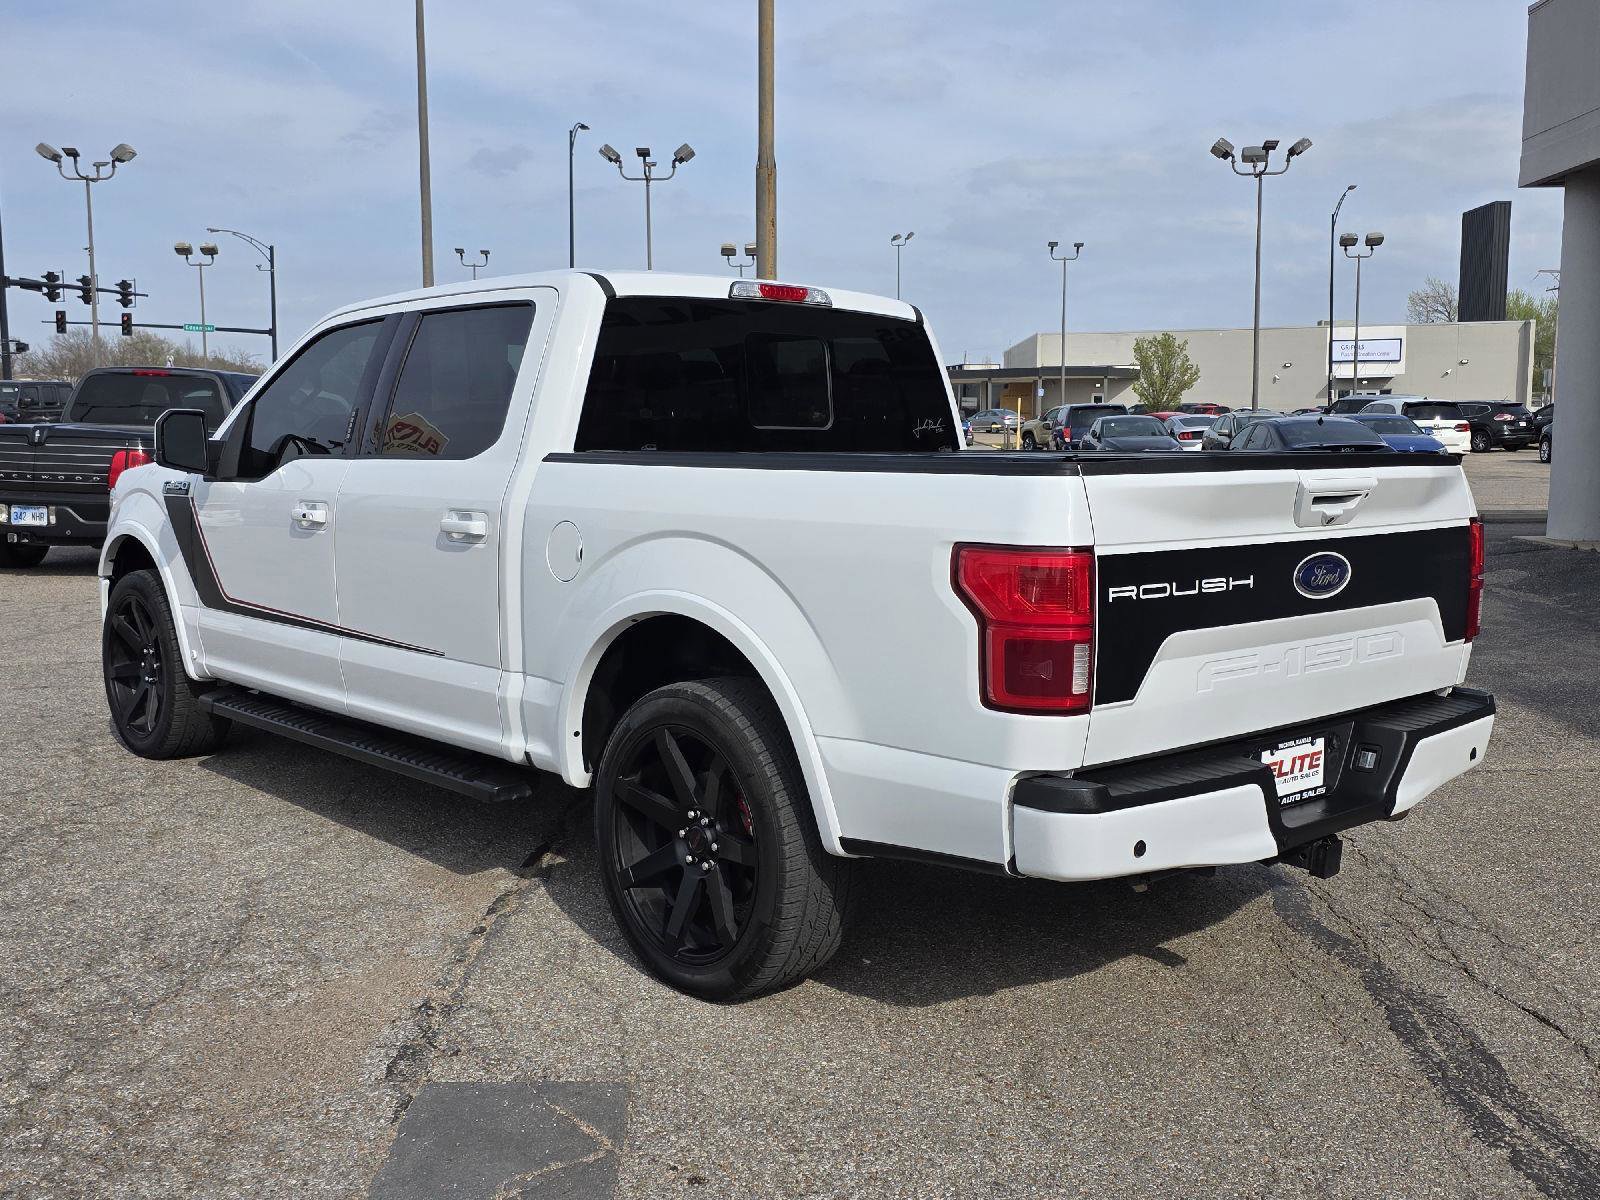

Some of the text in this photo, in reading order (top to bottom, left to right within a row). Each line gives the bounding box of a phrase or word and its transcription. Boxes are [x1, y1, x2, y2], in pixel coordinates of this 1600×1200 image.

[13, 511, 27, 521] 342
[1108, 575, 1254, 603] ROUSH
[1196, 630, 1406, 695] F-150
[1267, 749, 1323, 778] ELITE
[1281, 769, 1320, 785] AUTO SALES
[1280, 786, 1327, 805] AUTO SALES
